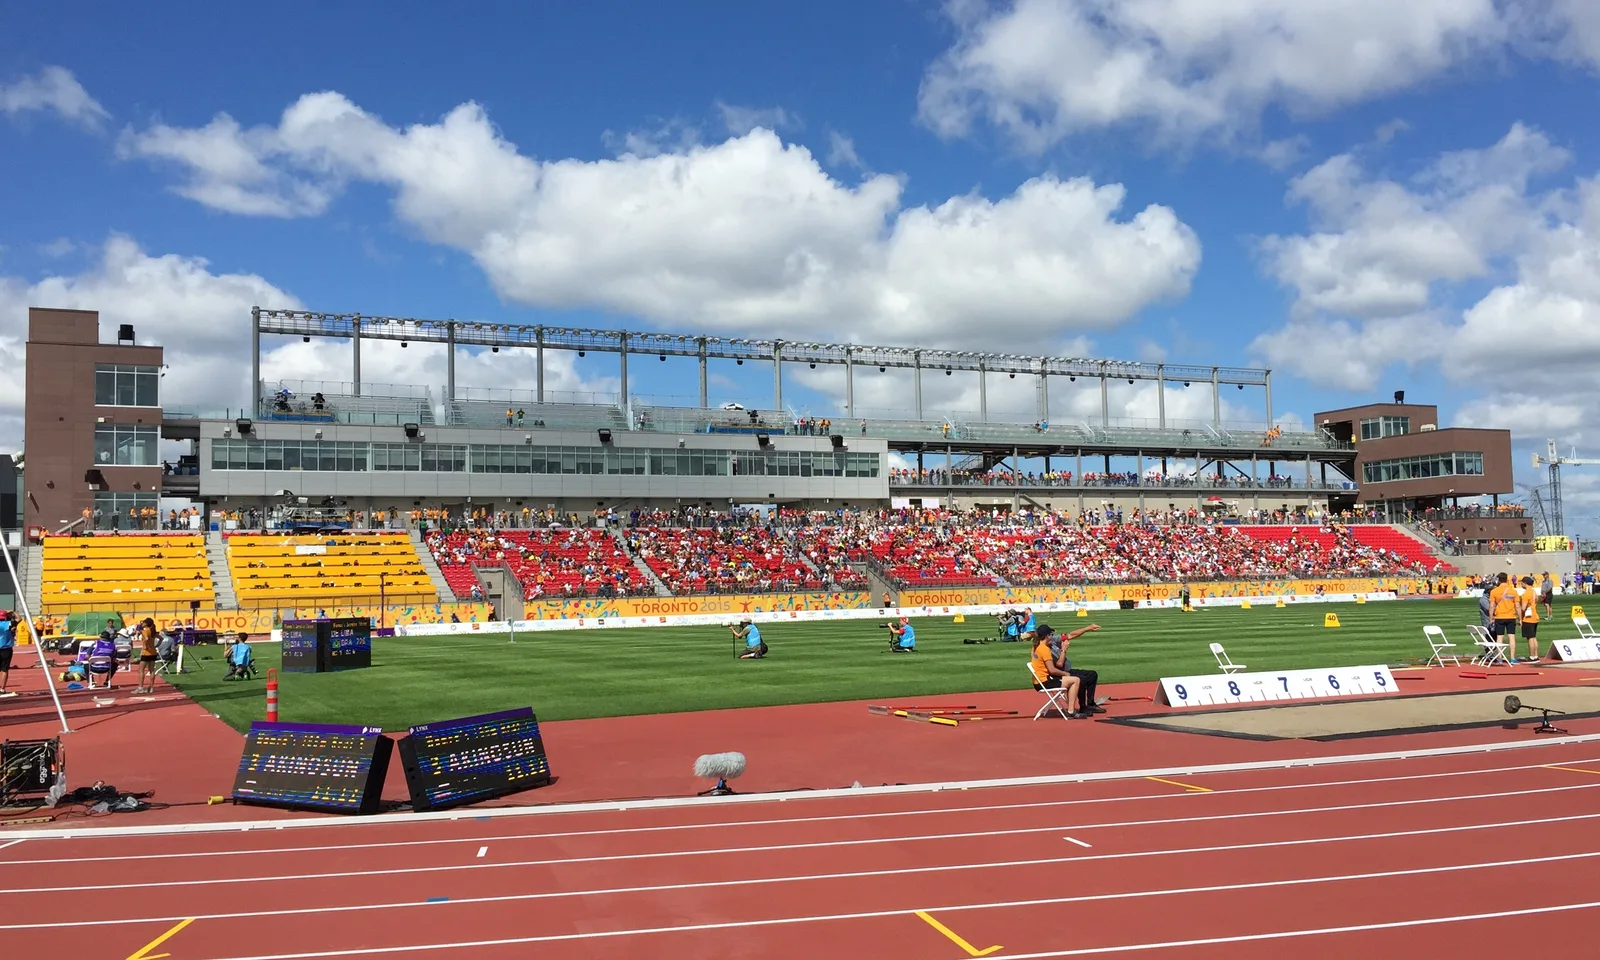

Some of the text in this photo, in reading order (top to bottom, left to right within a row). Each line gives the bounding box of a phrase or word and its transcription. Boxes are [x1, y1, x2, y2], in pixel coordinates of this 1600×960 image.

[908, 593, 990, 605] TORONTO 2015
[632, 601, 731, 614] TORONTO 2015
[1326, 614, 1337, 622] 40
[1563, 644, 1572, 656] 9
[1174, 671, 1386, 700] 9 8 7 6 5
